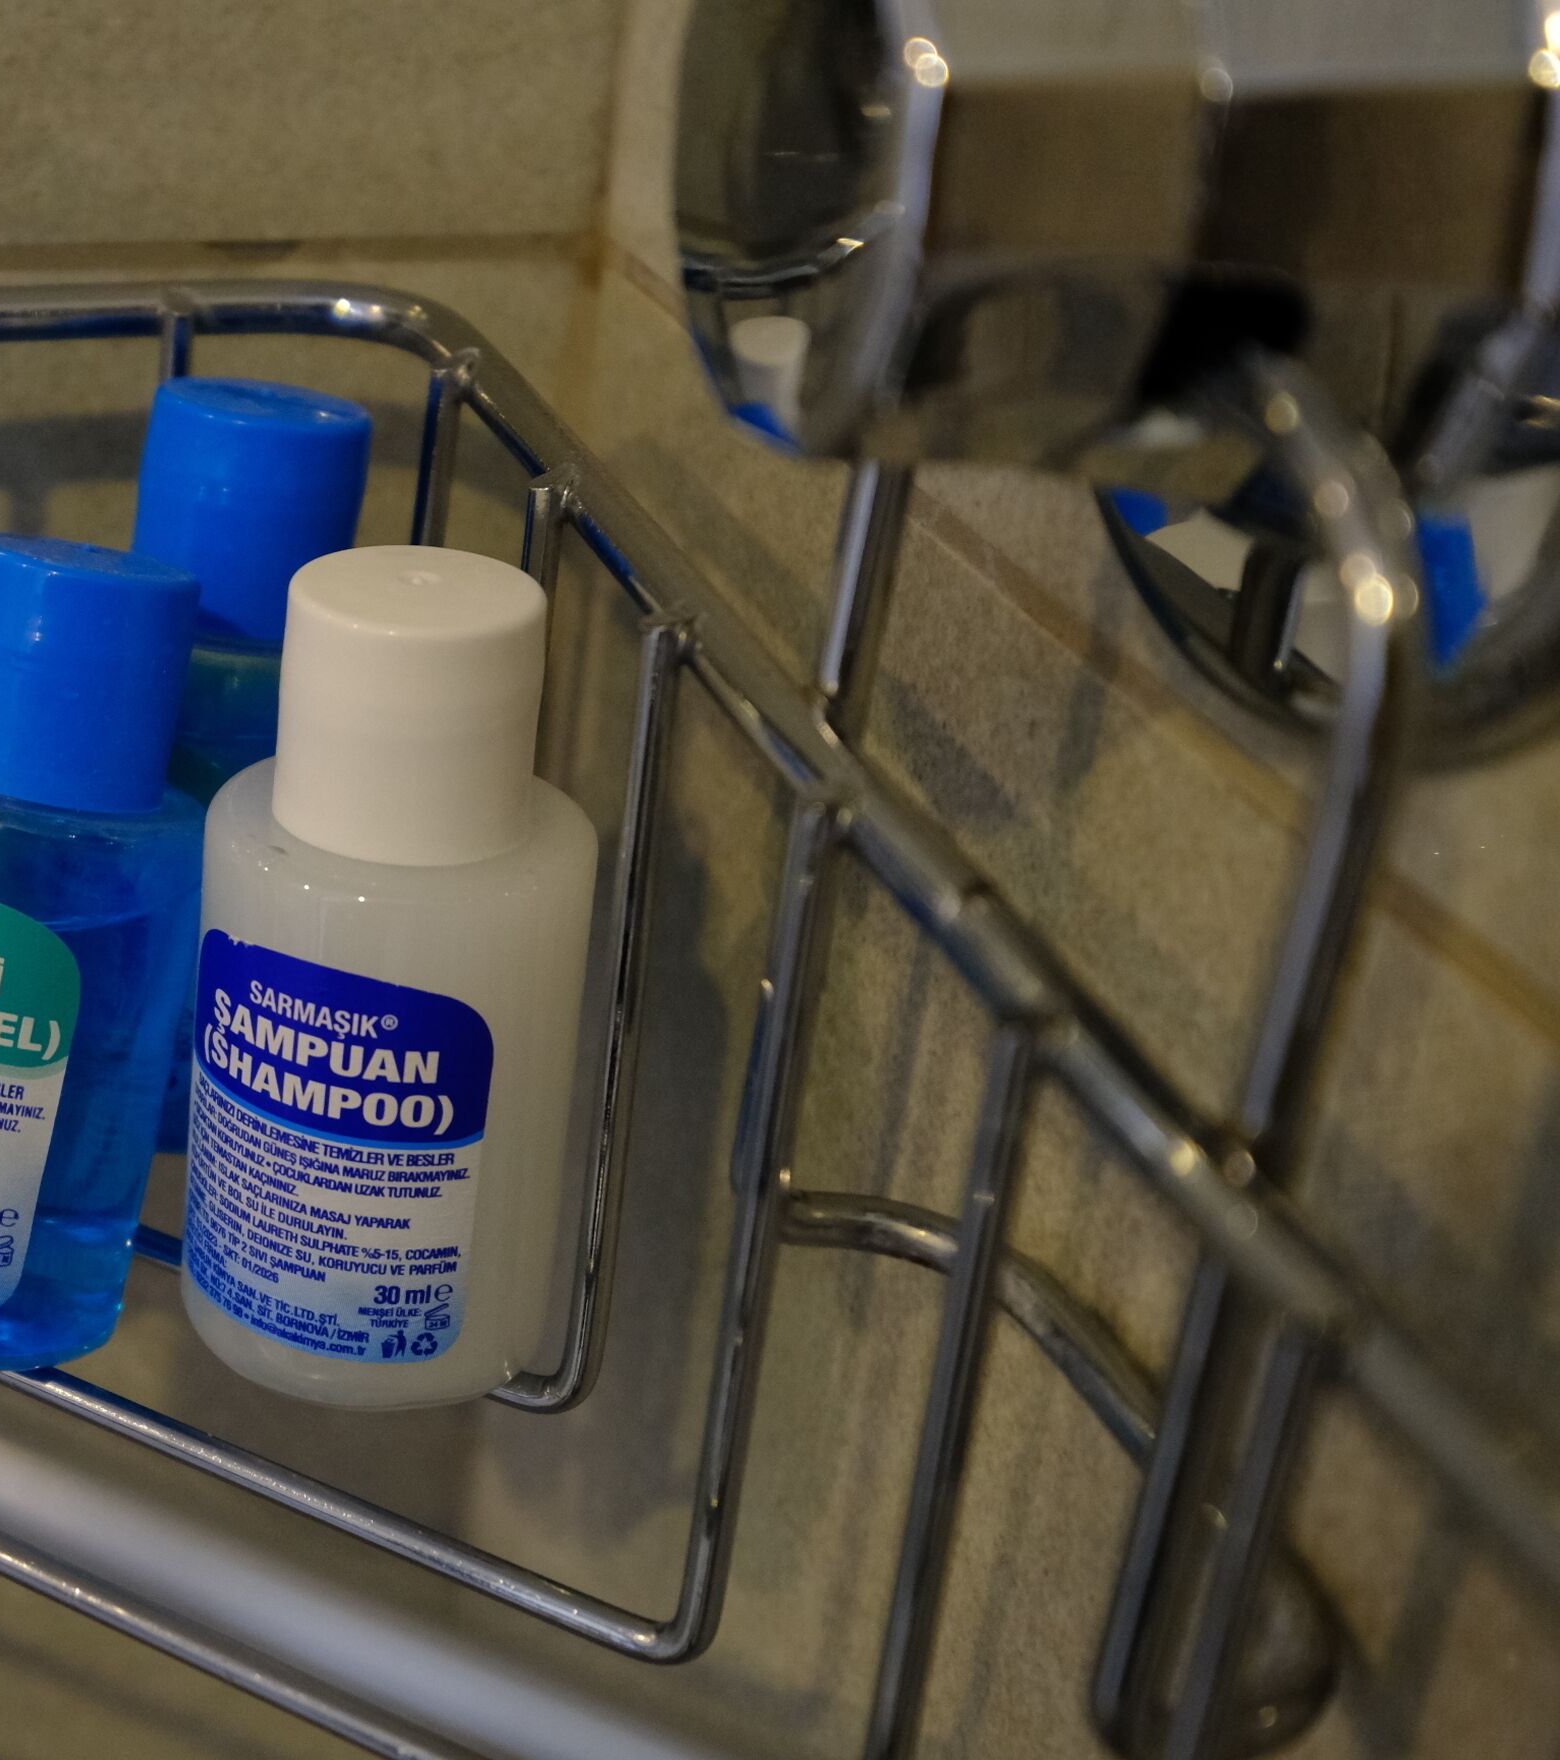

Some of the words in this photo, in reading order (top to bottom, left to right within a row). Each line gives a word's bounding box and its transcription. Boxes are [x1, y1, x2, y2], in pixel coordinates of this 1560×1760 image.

[213, 988, 440, 1084] ŞAMPUAN
[203, 1022, 454, 1136] (SHAMPOO)
[263, 1140, 297, 1166] GÜNEŞ
[299, 1155, 340, 1176] IŞIĞINA
[342, 1165, 386, 1181] MARUZ
[322, 1142, 385, 1166] TEMİZLER
[387, 1153, 404, 1167] VE
[405, 1153, 455, 1167] BESLER
[218, 1160, 240, 1186] ISLAK
[241, 1177, 307, 1215] SAÇLARINIZA
[310, 1206, 351, 1225] MASAJ
[354, 1214, 412, 1230] YAPARAK
[248, 1165, 299, 1197] KAÇININIZ.
[272, 1161, 353, 1193] ÇOCUKLARDAN
[354, 1183, 386, 1198] UZAK
[217, 1178, 227, 1192] VE
[228, 1181, 243, 1204] BOL
[245, 1195, 259, 1212] SU
[261, 1200, 276, 1219] İLE
[278, 1210, 348, 1241] DURULAYIN.
[219, 1194, 252, 1224] SODIUM
[252, 1213, 298, 1243] LAURETH
[300, 1233, 359, 1257] SULPHATE
[241, 1240, 248, 1252] 2
[249, 1244, 268, 1262] SIVI
[270, 1255, 326, 1282] ŞAMPUAN
[242, 1257, 280, 1284] 01/2026
[247, 1228, 294, 1257] DEIONIZE
[318, 1254, 387, 1276] KORUYUCU
[390, 1264, 405, 1276] VE
[408, 1260, 458, 1276] PARFÜM
[373, 1284, 401, 1305] 30
[405, 1284, 432, 1305] ml
[276, 1312, 329, 1338] BORNOVA
